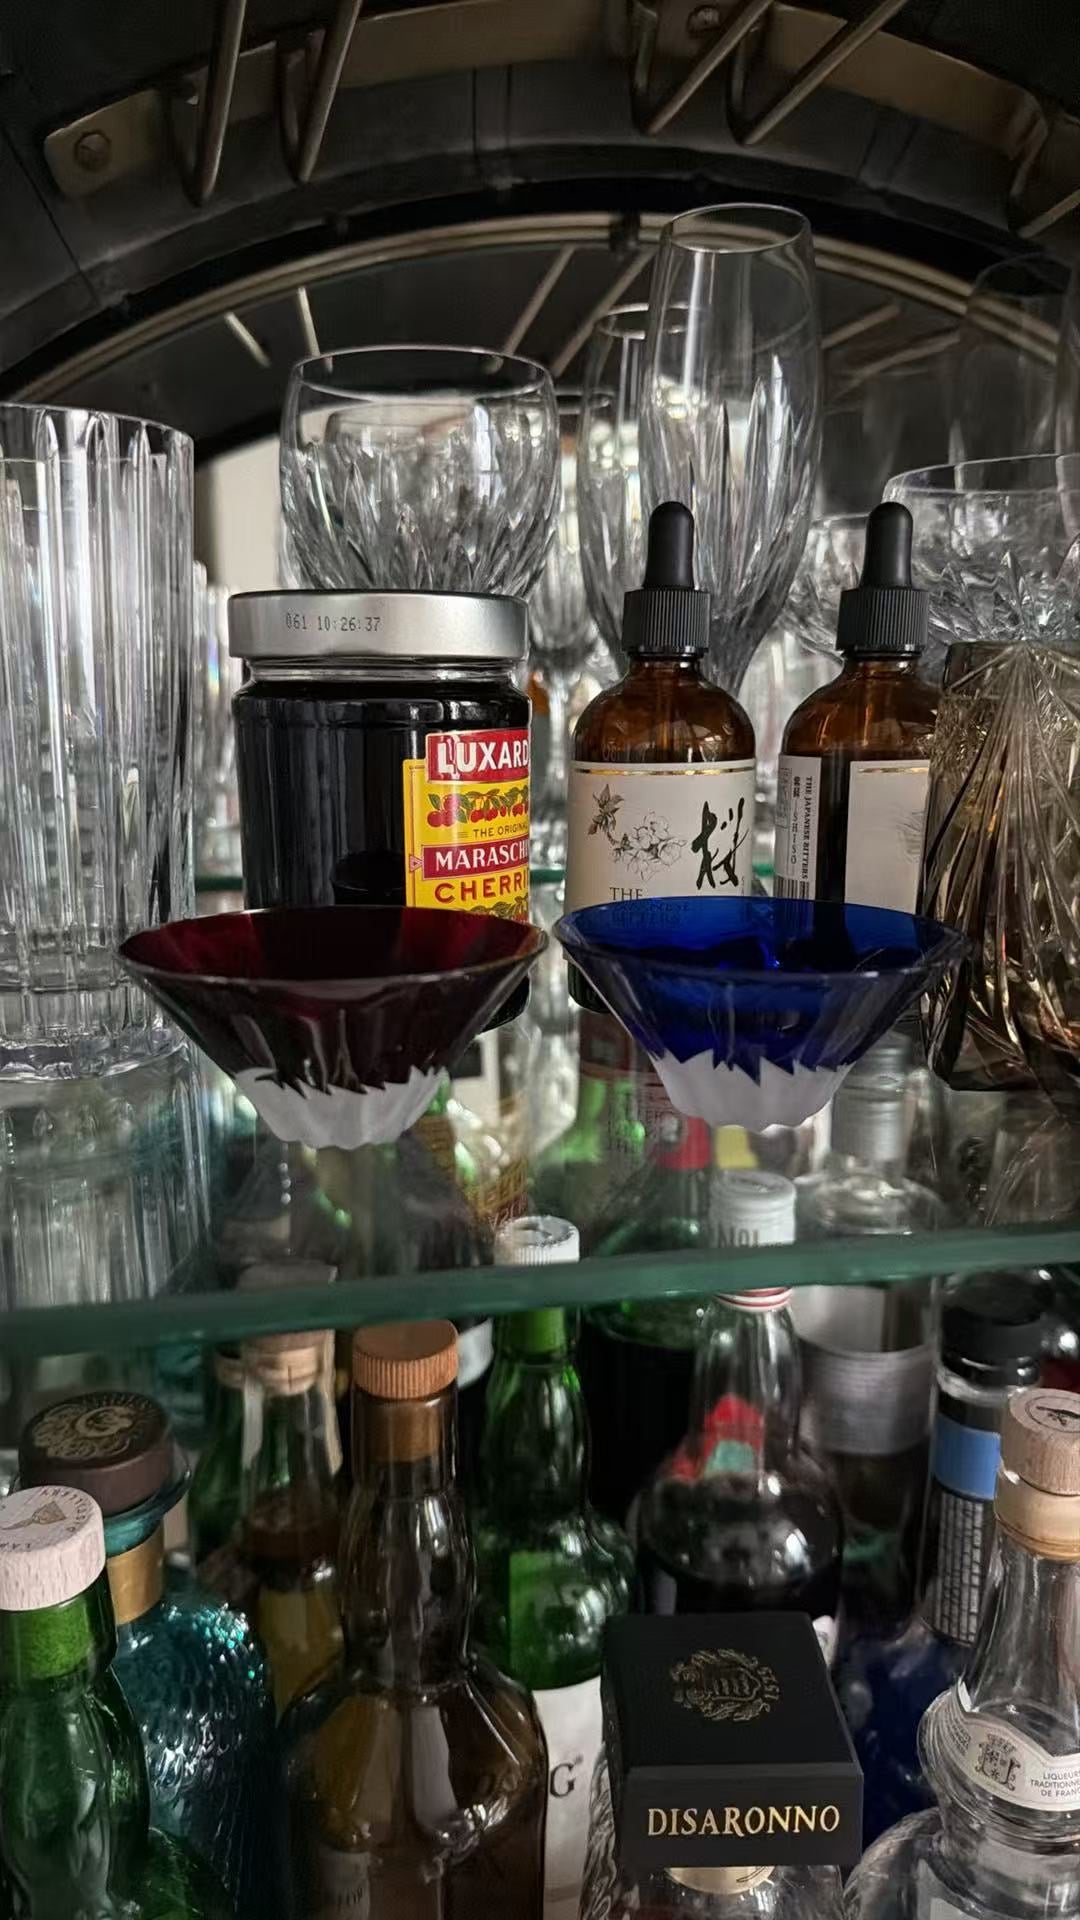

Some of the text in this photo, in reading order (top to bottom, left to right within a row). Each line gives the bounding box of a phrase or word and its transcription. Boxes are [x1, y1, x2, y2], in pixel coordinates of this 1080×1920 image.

[317, 615, 381, 632] 10:26:37
[473, 827, 494, 838] THE
[801, 775, 813, 880] THE JAPANESE BITTERS
[609, 887, 643, 900] THE
[549, 1762, 576, 1798] G
[1041, 1789, 1052, 1797] DE
[648, 1804, 840, 1838] DISARONNO
